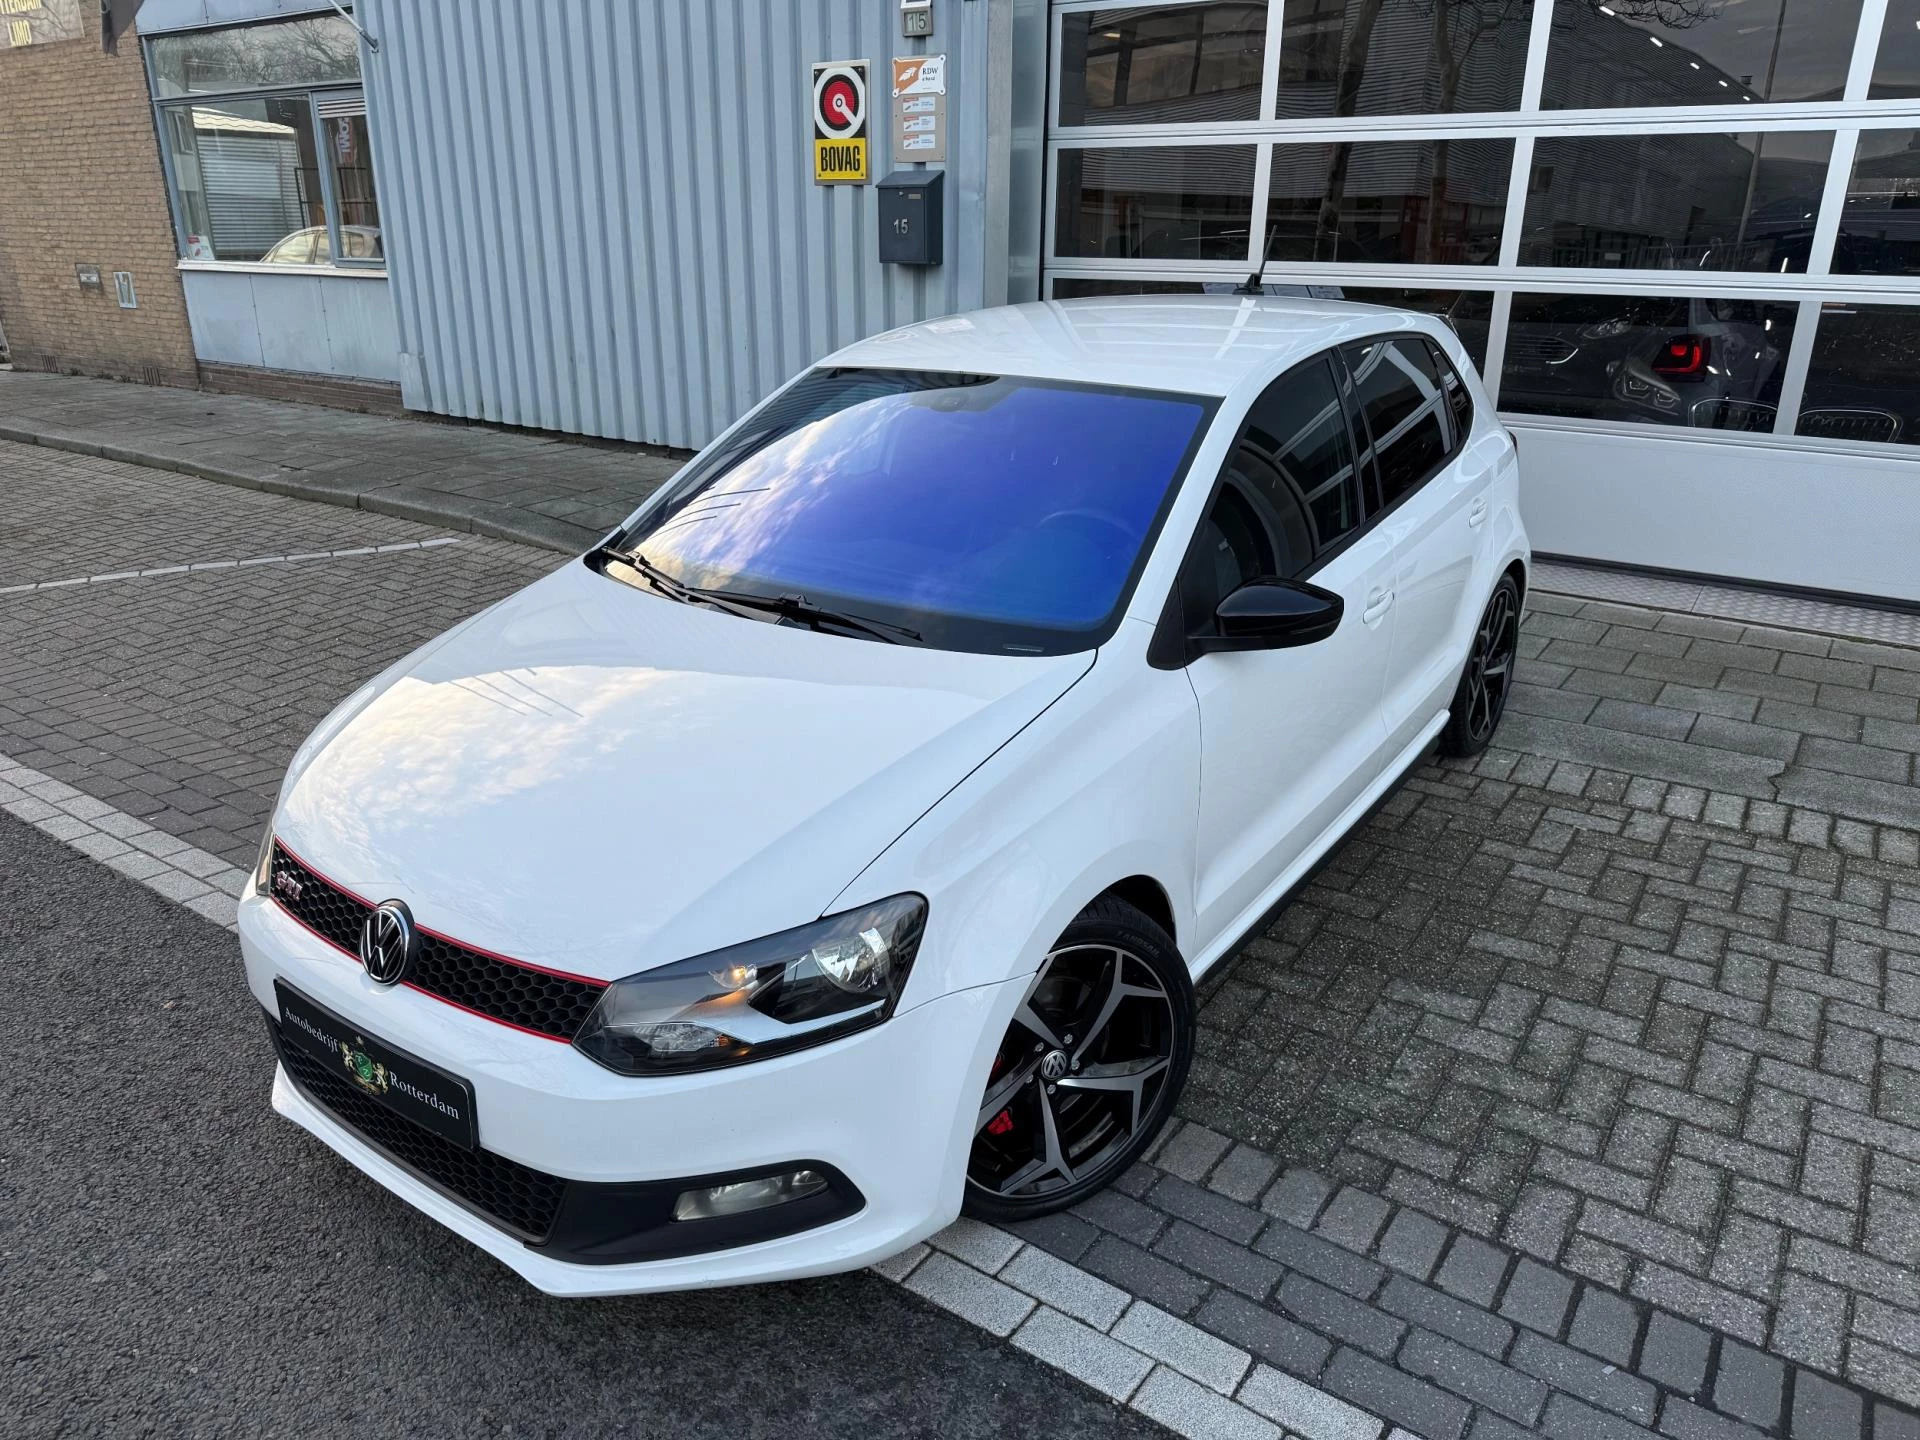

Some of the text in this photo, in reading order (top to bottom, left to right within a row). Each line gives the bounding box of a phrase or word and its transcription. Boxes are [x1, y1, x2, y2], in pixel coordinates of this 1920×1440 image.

[6, 20, 32, 47] LIMO
[909, 13, 926, 31] 15
[820, 145, 861, 172] BOVAG
[893, 218, 909, 234] 15
[276, 870, 303, 901] GTI
[284, 1006, 460, 1120] Autobedrijf Rotterdam
